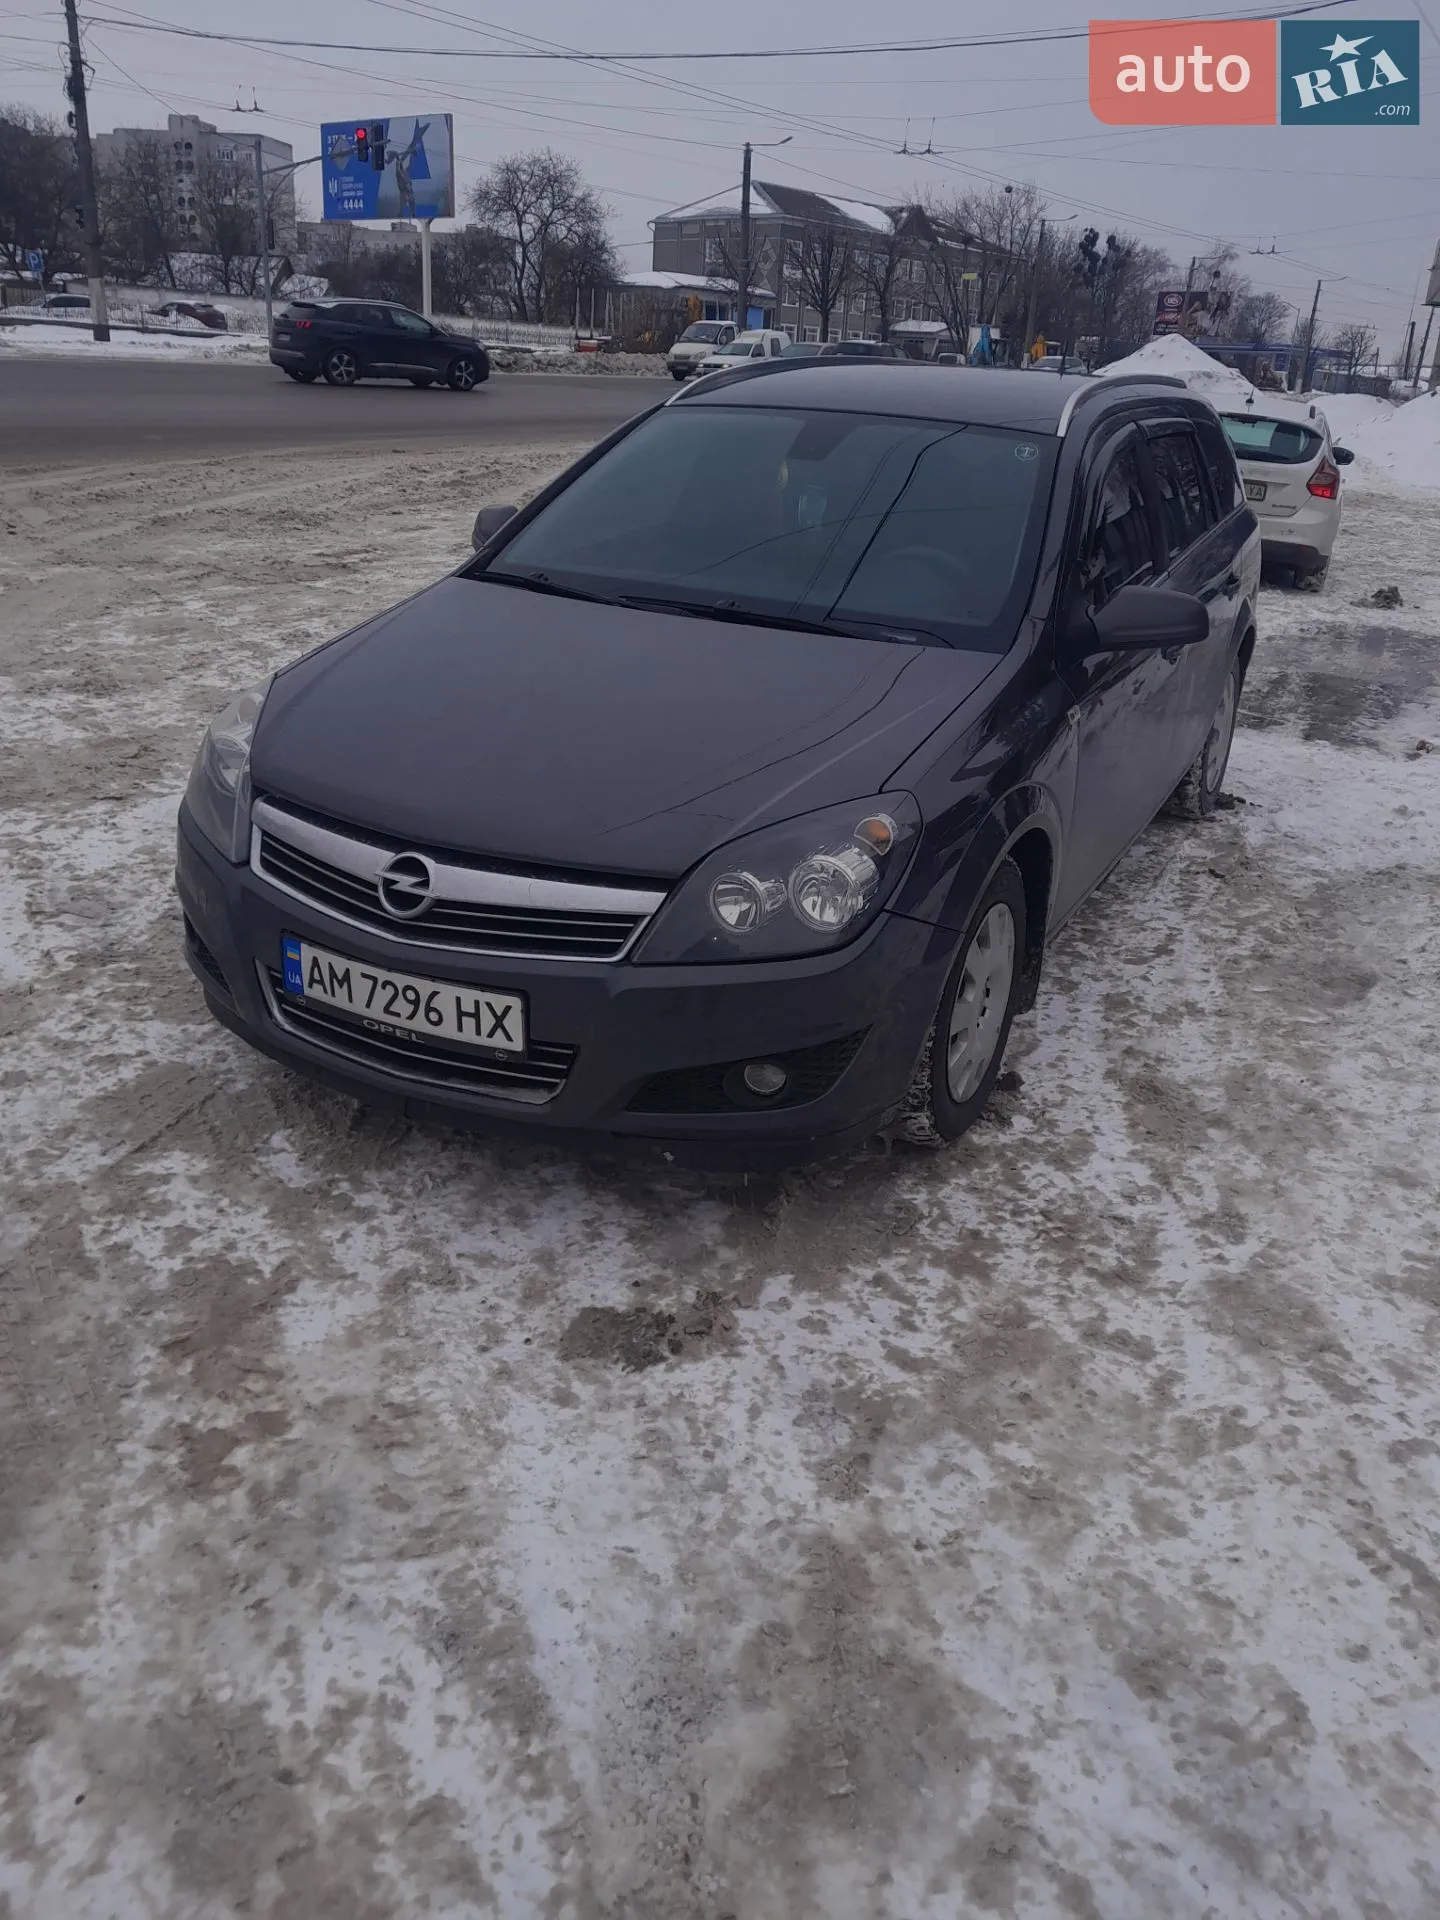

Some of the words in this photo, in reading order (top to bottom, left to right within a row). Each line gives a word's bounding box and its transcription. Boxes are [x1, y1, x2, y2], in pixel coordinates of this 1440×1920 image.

[343, 199, 364, 210] 4444
[29, 252, 39, 268] P
[288, 971, 303, 986] UA
[308, 955, 354, 1004] AM
[360, 972, 444, 1027] 7296
[455, 996, 514, 1042] HX
[362, 1019, 425, 1044] OPEL
